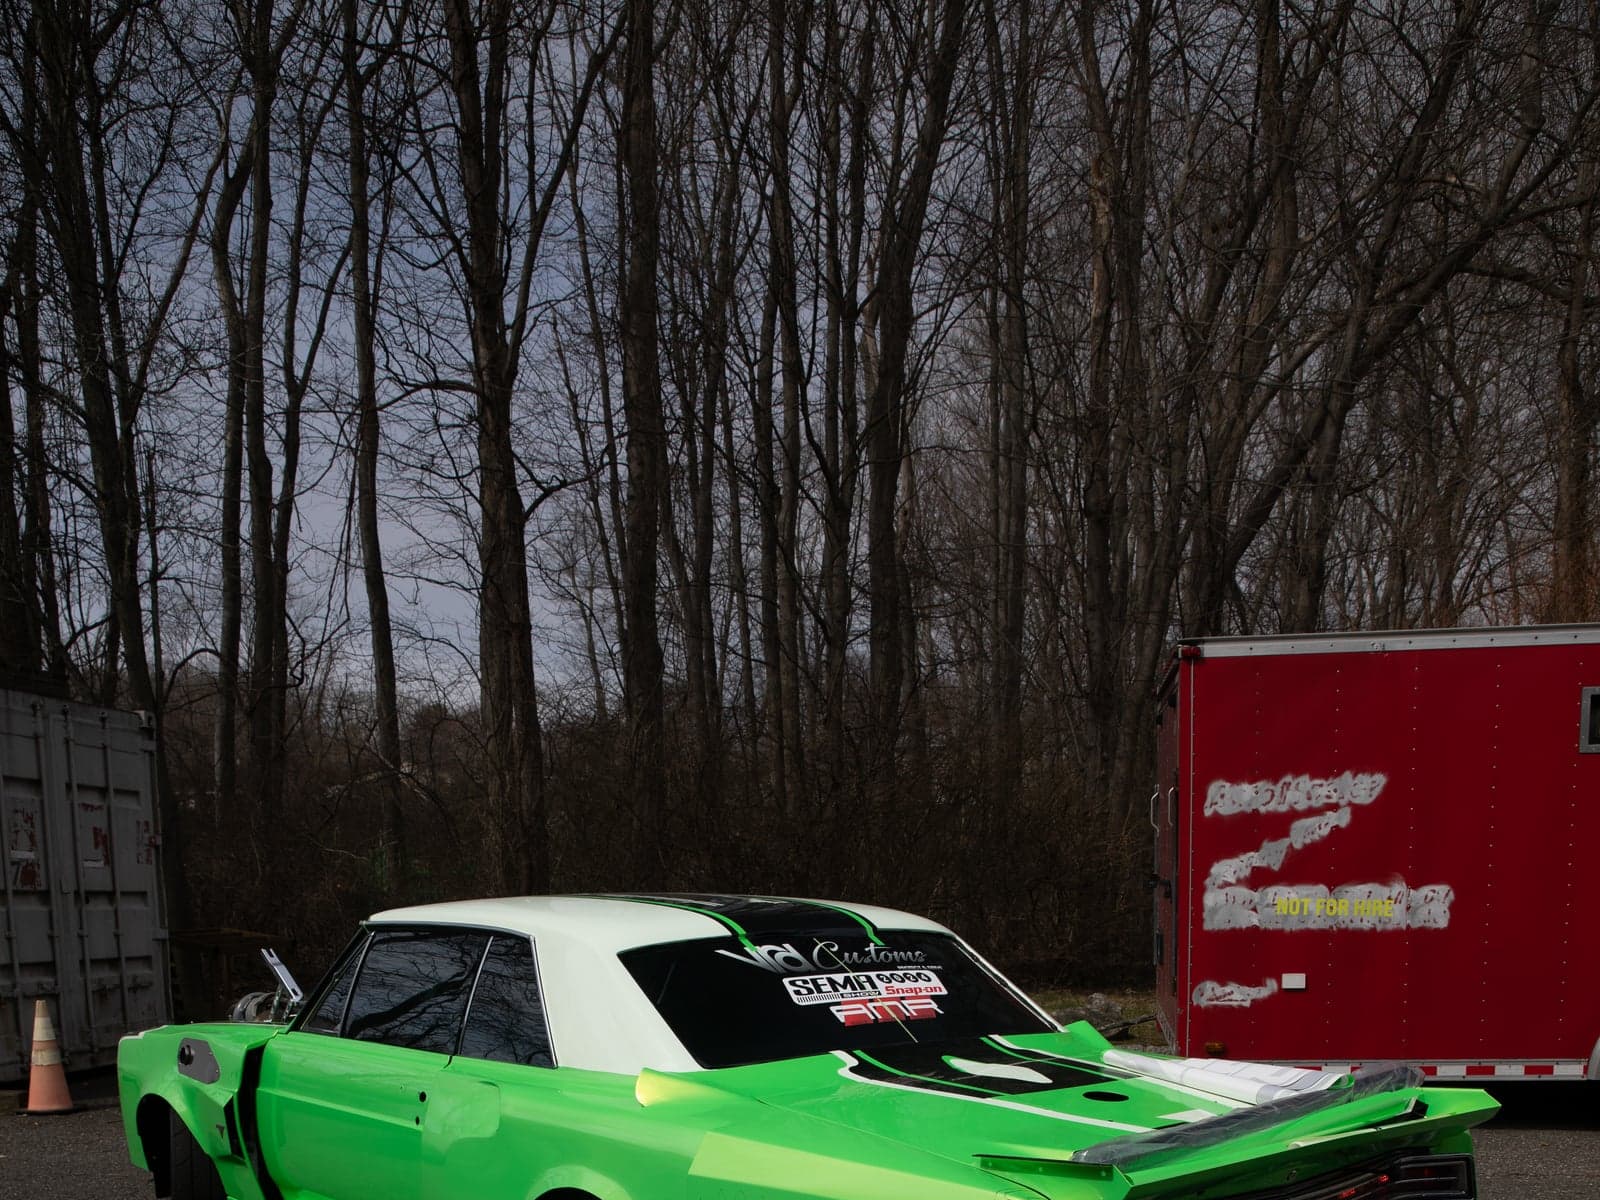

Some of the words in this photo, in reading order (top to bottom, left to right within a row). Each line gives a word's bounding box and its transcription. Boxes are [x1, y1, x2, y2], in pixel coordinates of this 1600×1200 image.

[1276, 897, 1312, 916] NOT
[1315, 897, 1350, 917] FOR
[1354, 898, 1394, 917] HIRE
[812, 940, 927, 971] Customs
[788, 974, 879, 996] SEMA
[885, 985, 943, 996] Snap-on
